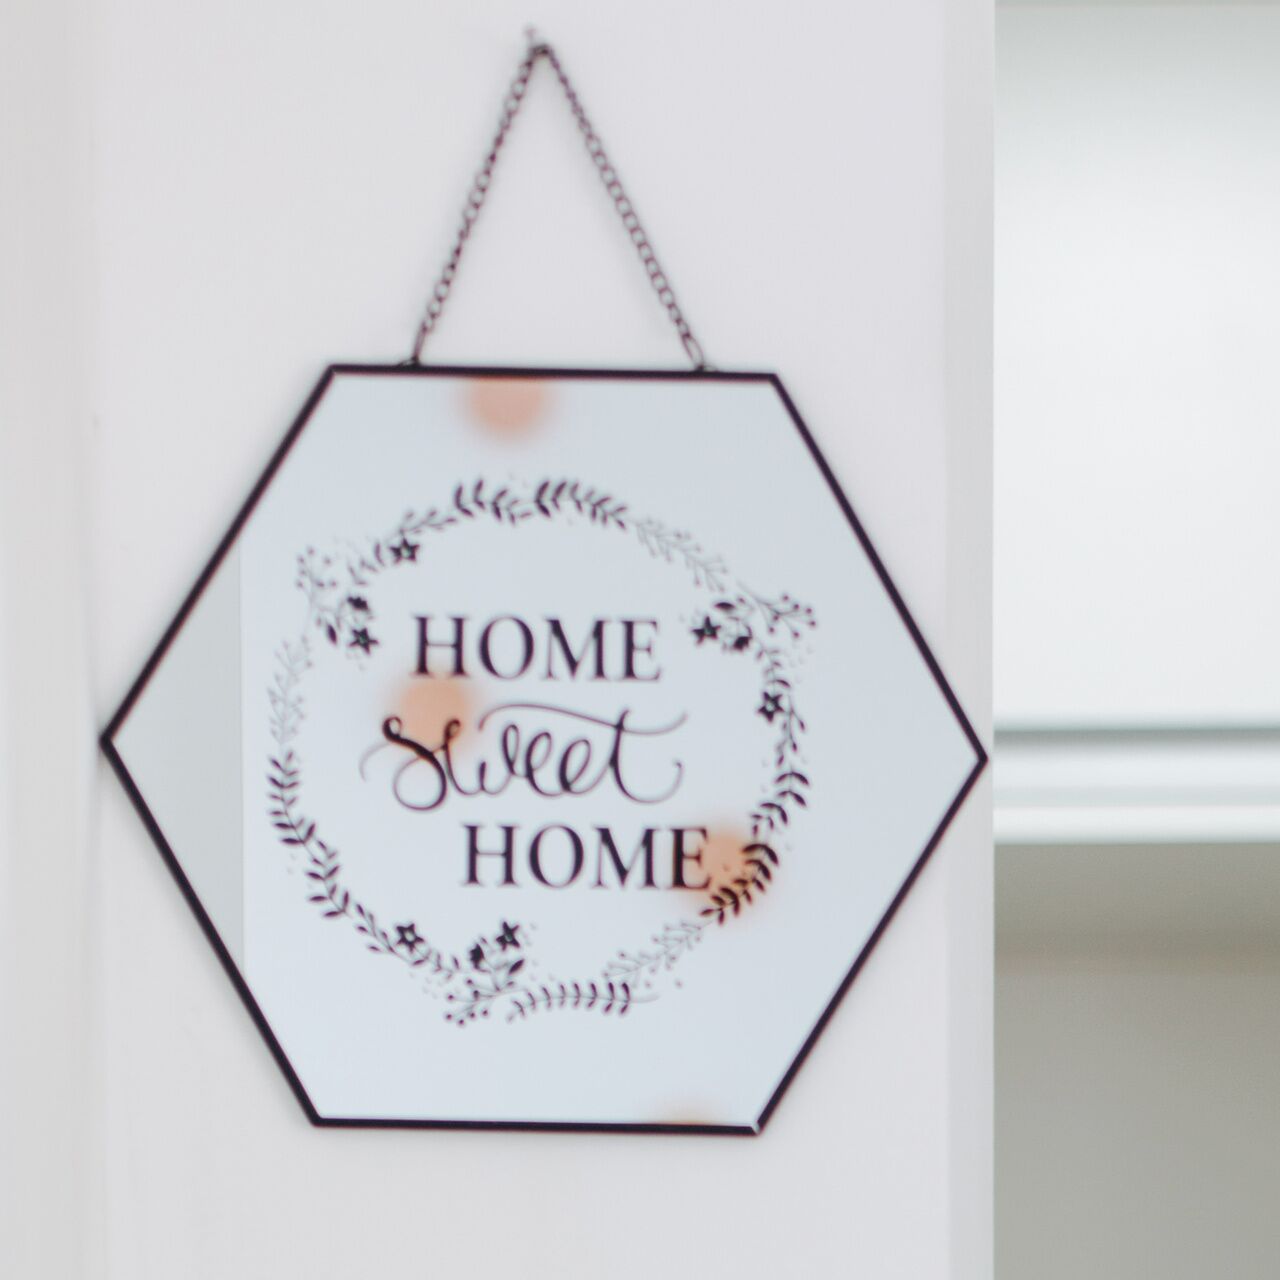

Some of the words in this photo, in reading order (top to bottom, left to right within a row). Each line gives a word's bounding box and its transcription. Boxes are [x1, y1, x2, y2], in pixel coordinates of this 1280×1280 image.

[409, 614, 662, 682] HOME
[359, 702, 688, 812] Sweet
[461, 823, 712, 891] HOME
